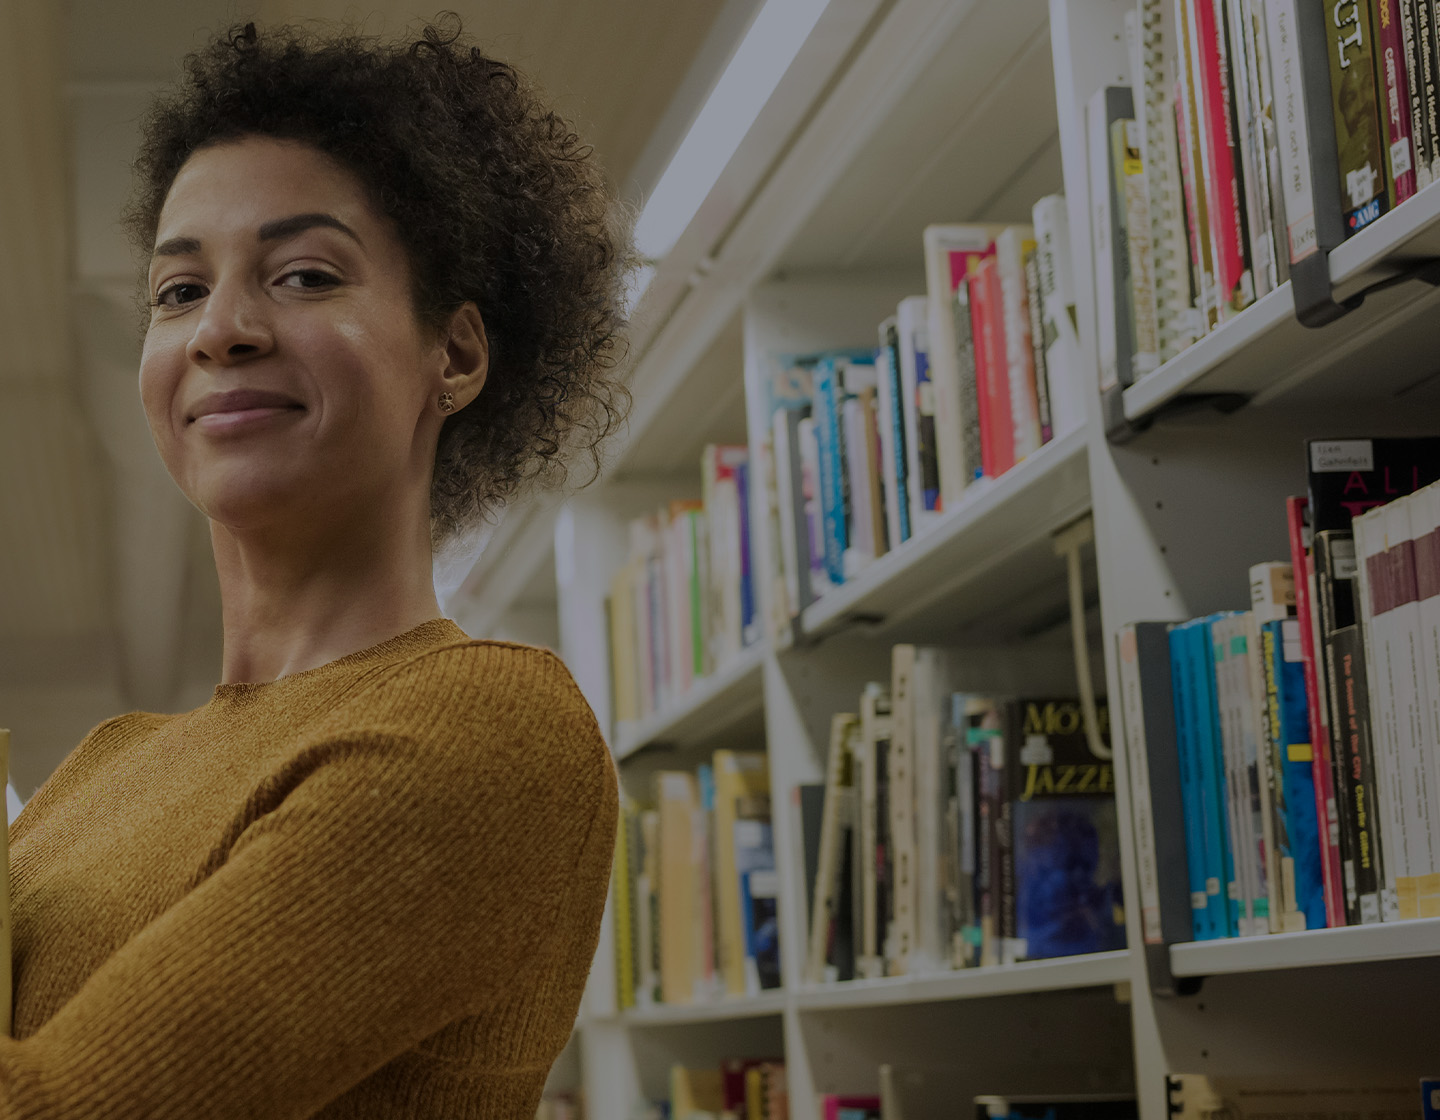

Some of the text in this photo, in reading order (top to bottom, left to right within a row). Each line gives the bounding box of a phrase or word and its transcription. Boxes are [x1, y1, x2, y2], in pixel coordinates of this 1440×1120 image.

[1343, 654, 1352, 676] The
[1345, 677, 1356, 715] Sound
[1348, 716, 1357, 729] of
[1351, 755, 1361, 780] City
[1354, 784, 1367, 828] Charlie
